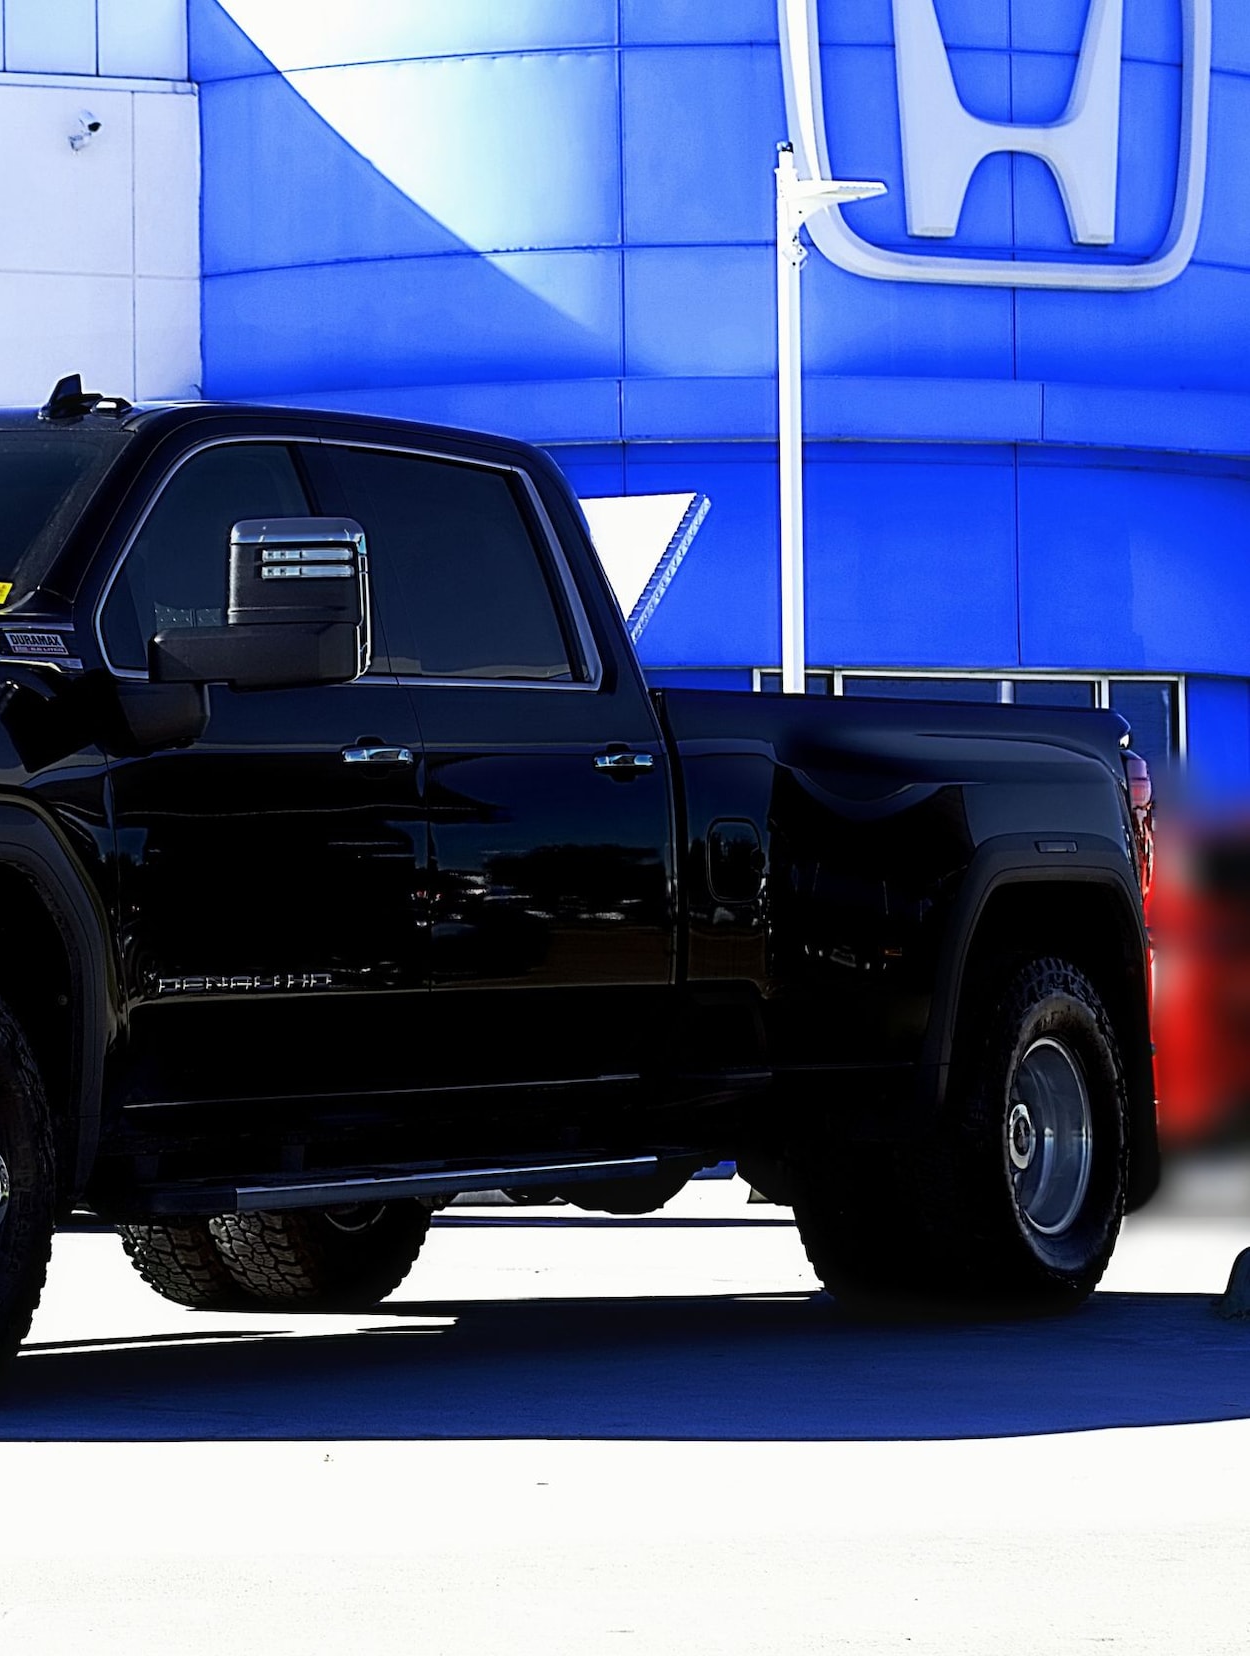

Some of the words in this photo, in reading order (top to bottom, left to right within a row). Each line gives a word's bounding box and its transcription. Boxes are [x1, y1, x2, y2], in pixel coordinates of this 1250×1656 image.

[9, 634, 62, 646] DURAMAX
[158, 975, 281, 993] DENALI
[287, 973, 332, 989] HD
